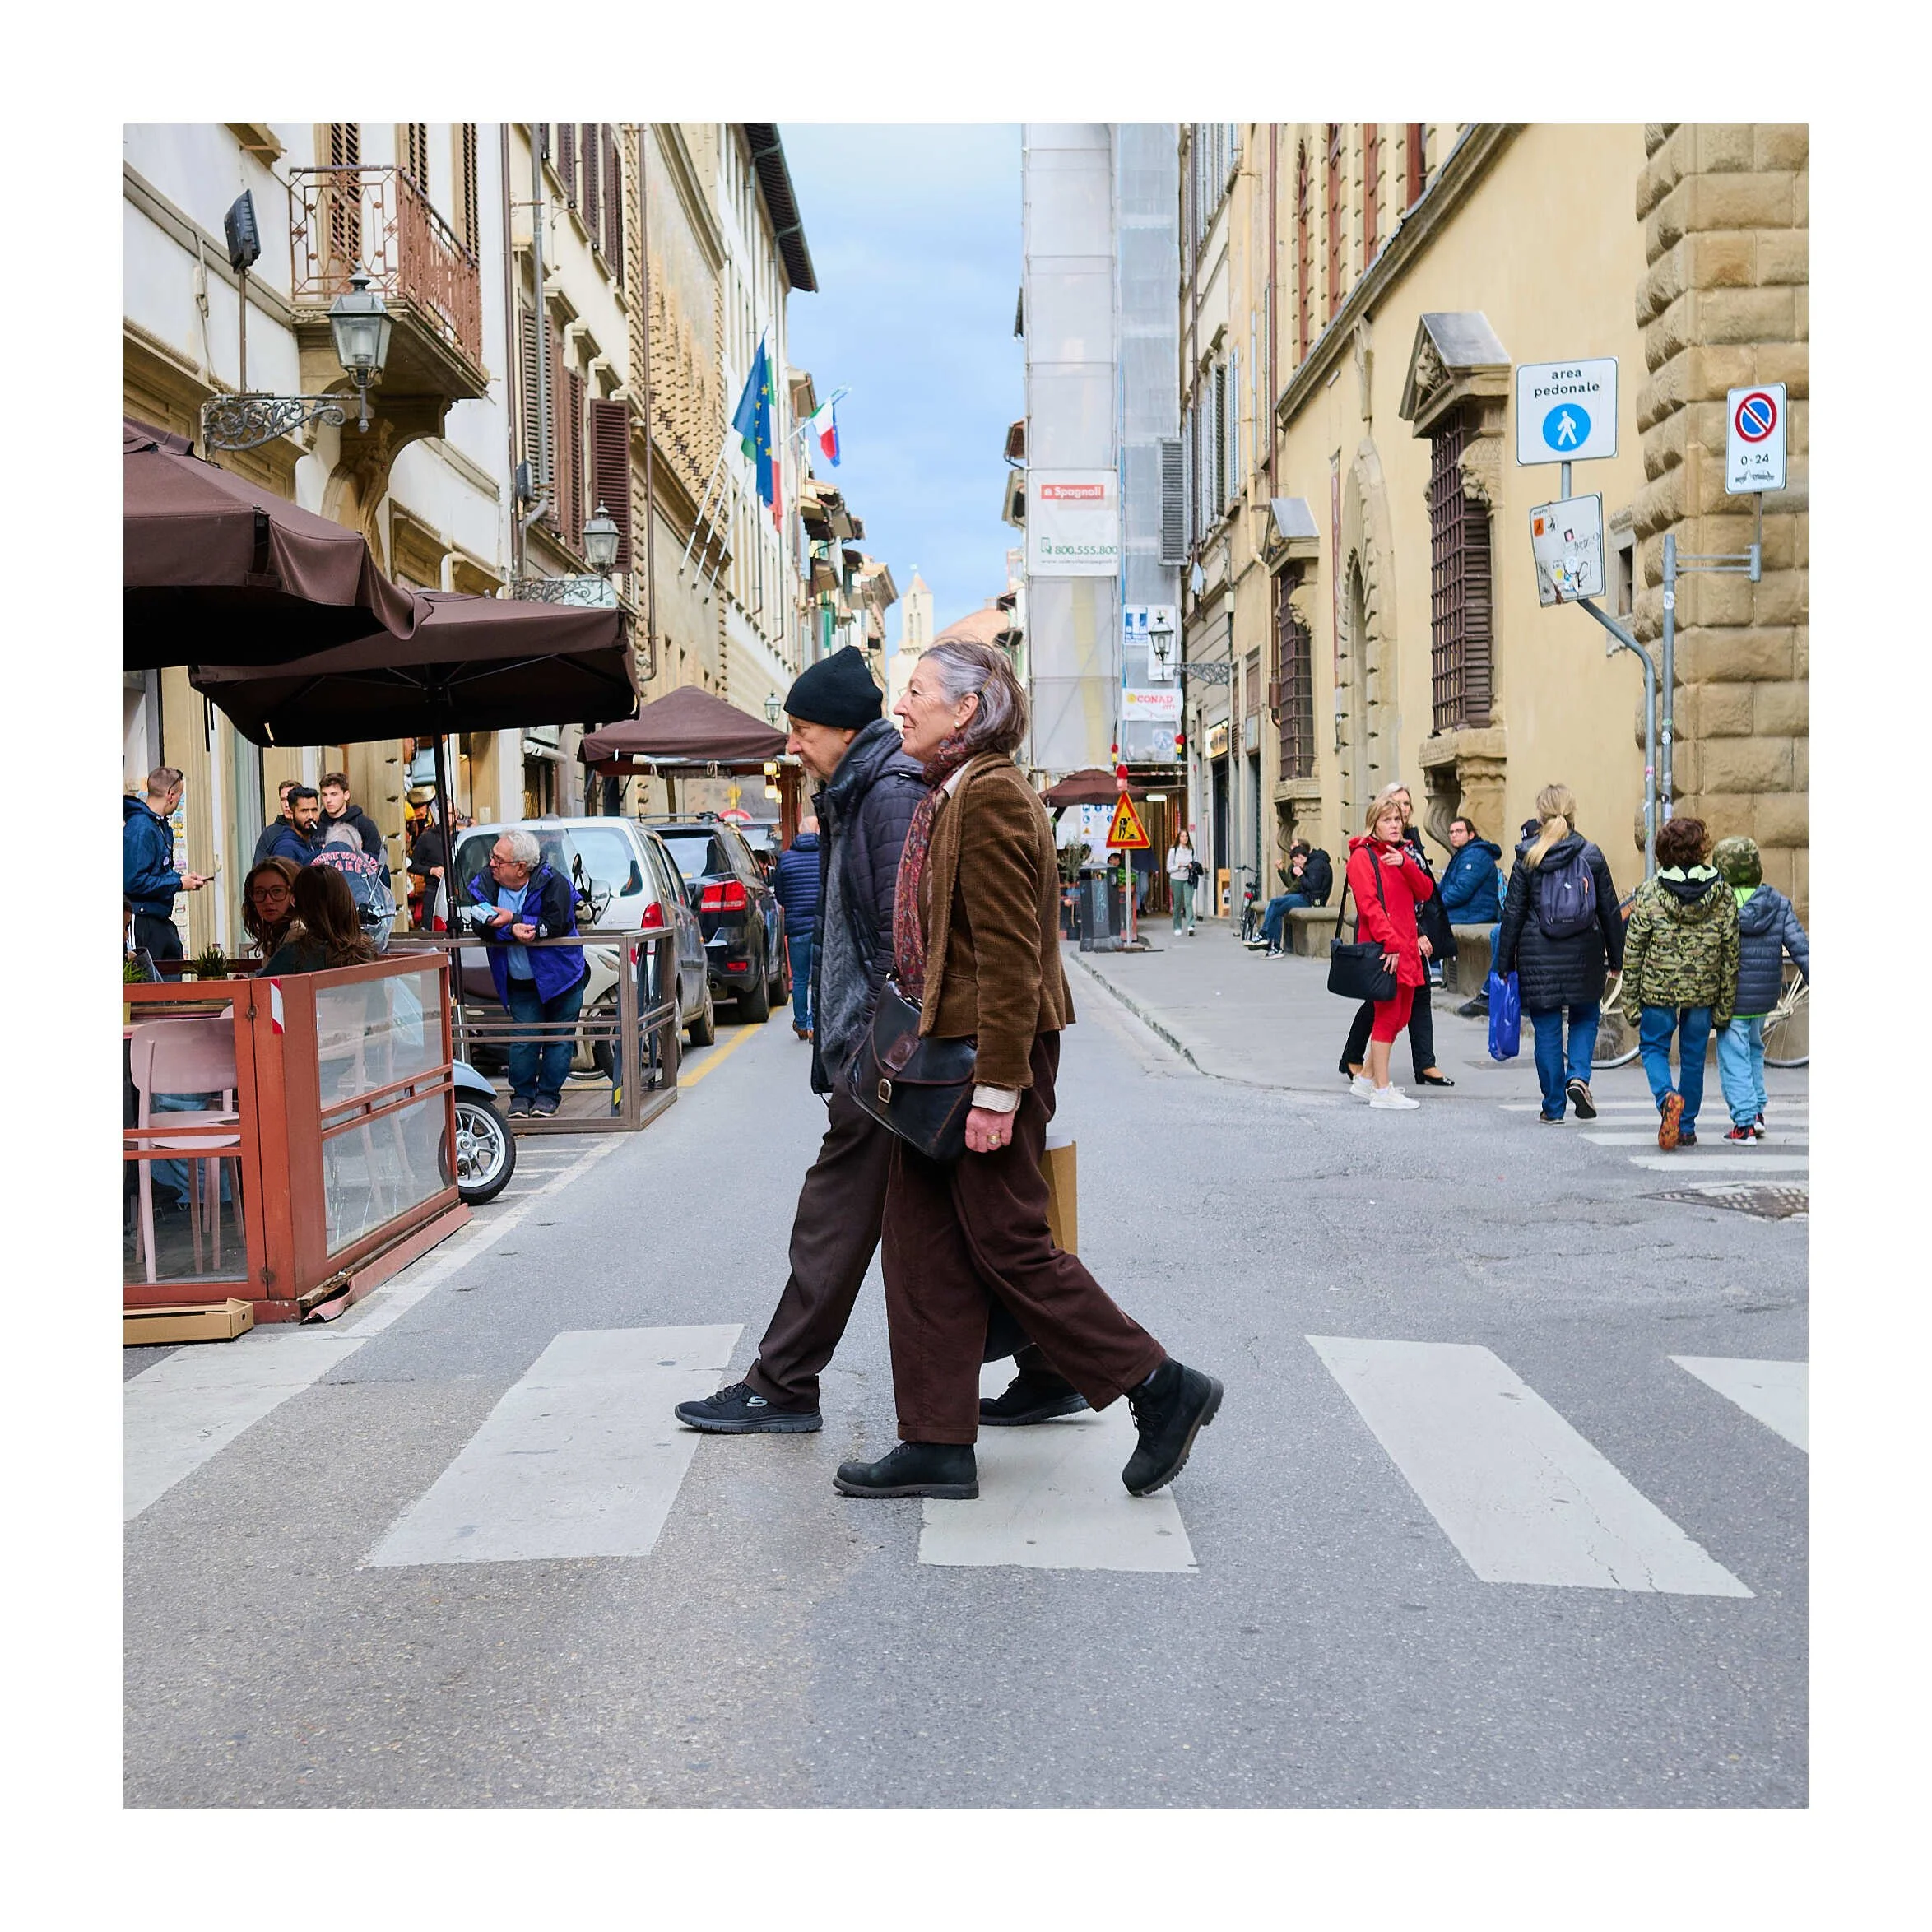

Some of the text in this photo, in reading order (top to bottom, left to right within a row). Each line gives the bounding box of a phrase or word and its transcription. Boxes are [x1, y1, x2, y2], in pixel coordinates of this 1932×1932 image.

[1552, 369, 1581, 379] area
[1535, 382, 1600, 398] pedonale
[1054, 486, 1102, 499] Spagnoli
[1054, 546, 1118, 555] 800.555.800
[1137, 695, 1173, 704] CONAD
